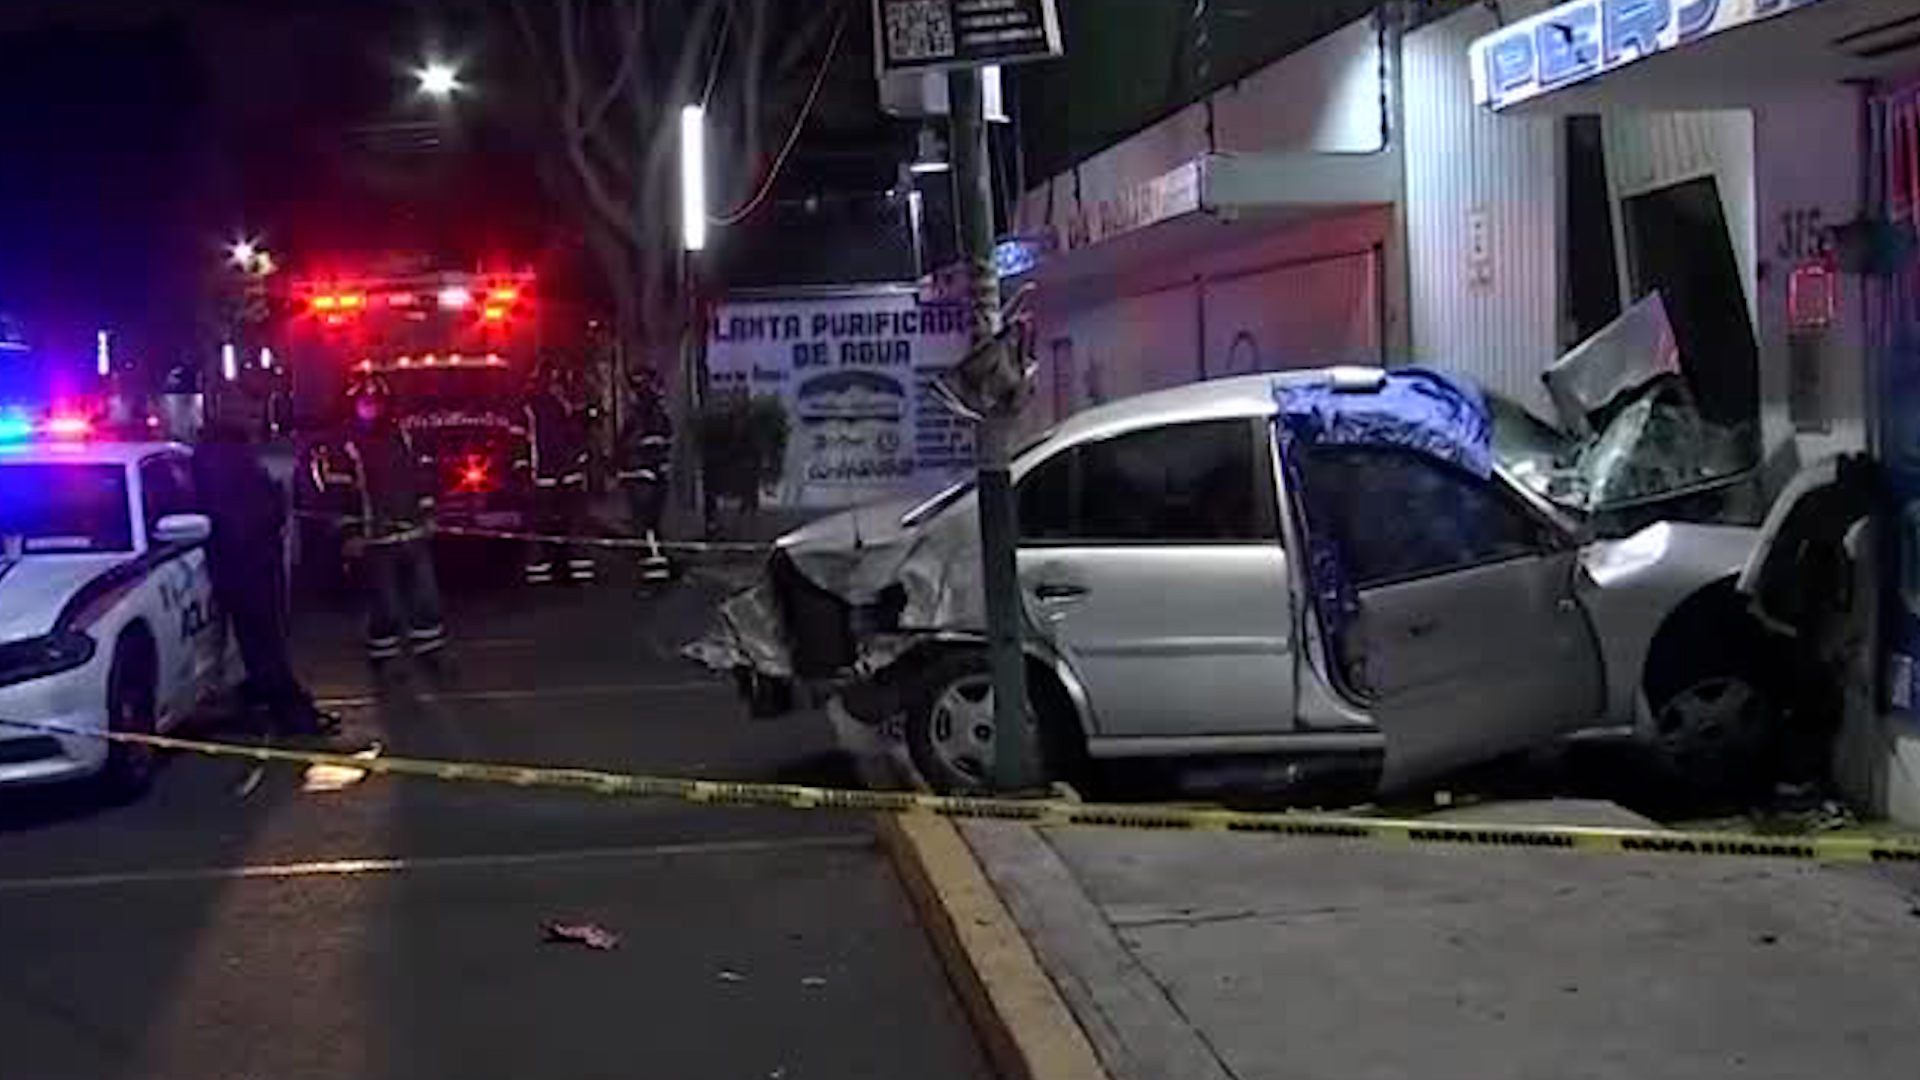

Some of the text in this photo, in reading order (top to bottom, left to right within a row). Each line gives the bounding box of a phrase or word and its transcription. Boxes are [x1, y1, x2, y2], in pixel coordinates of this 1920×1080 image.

[713, 310, 973, 343] LANTA PURIFICADO
[793, 343, 829, 368] DE
